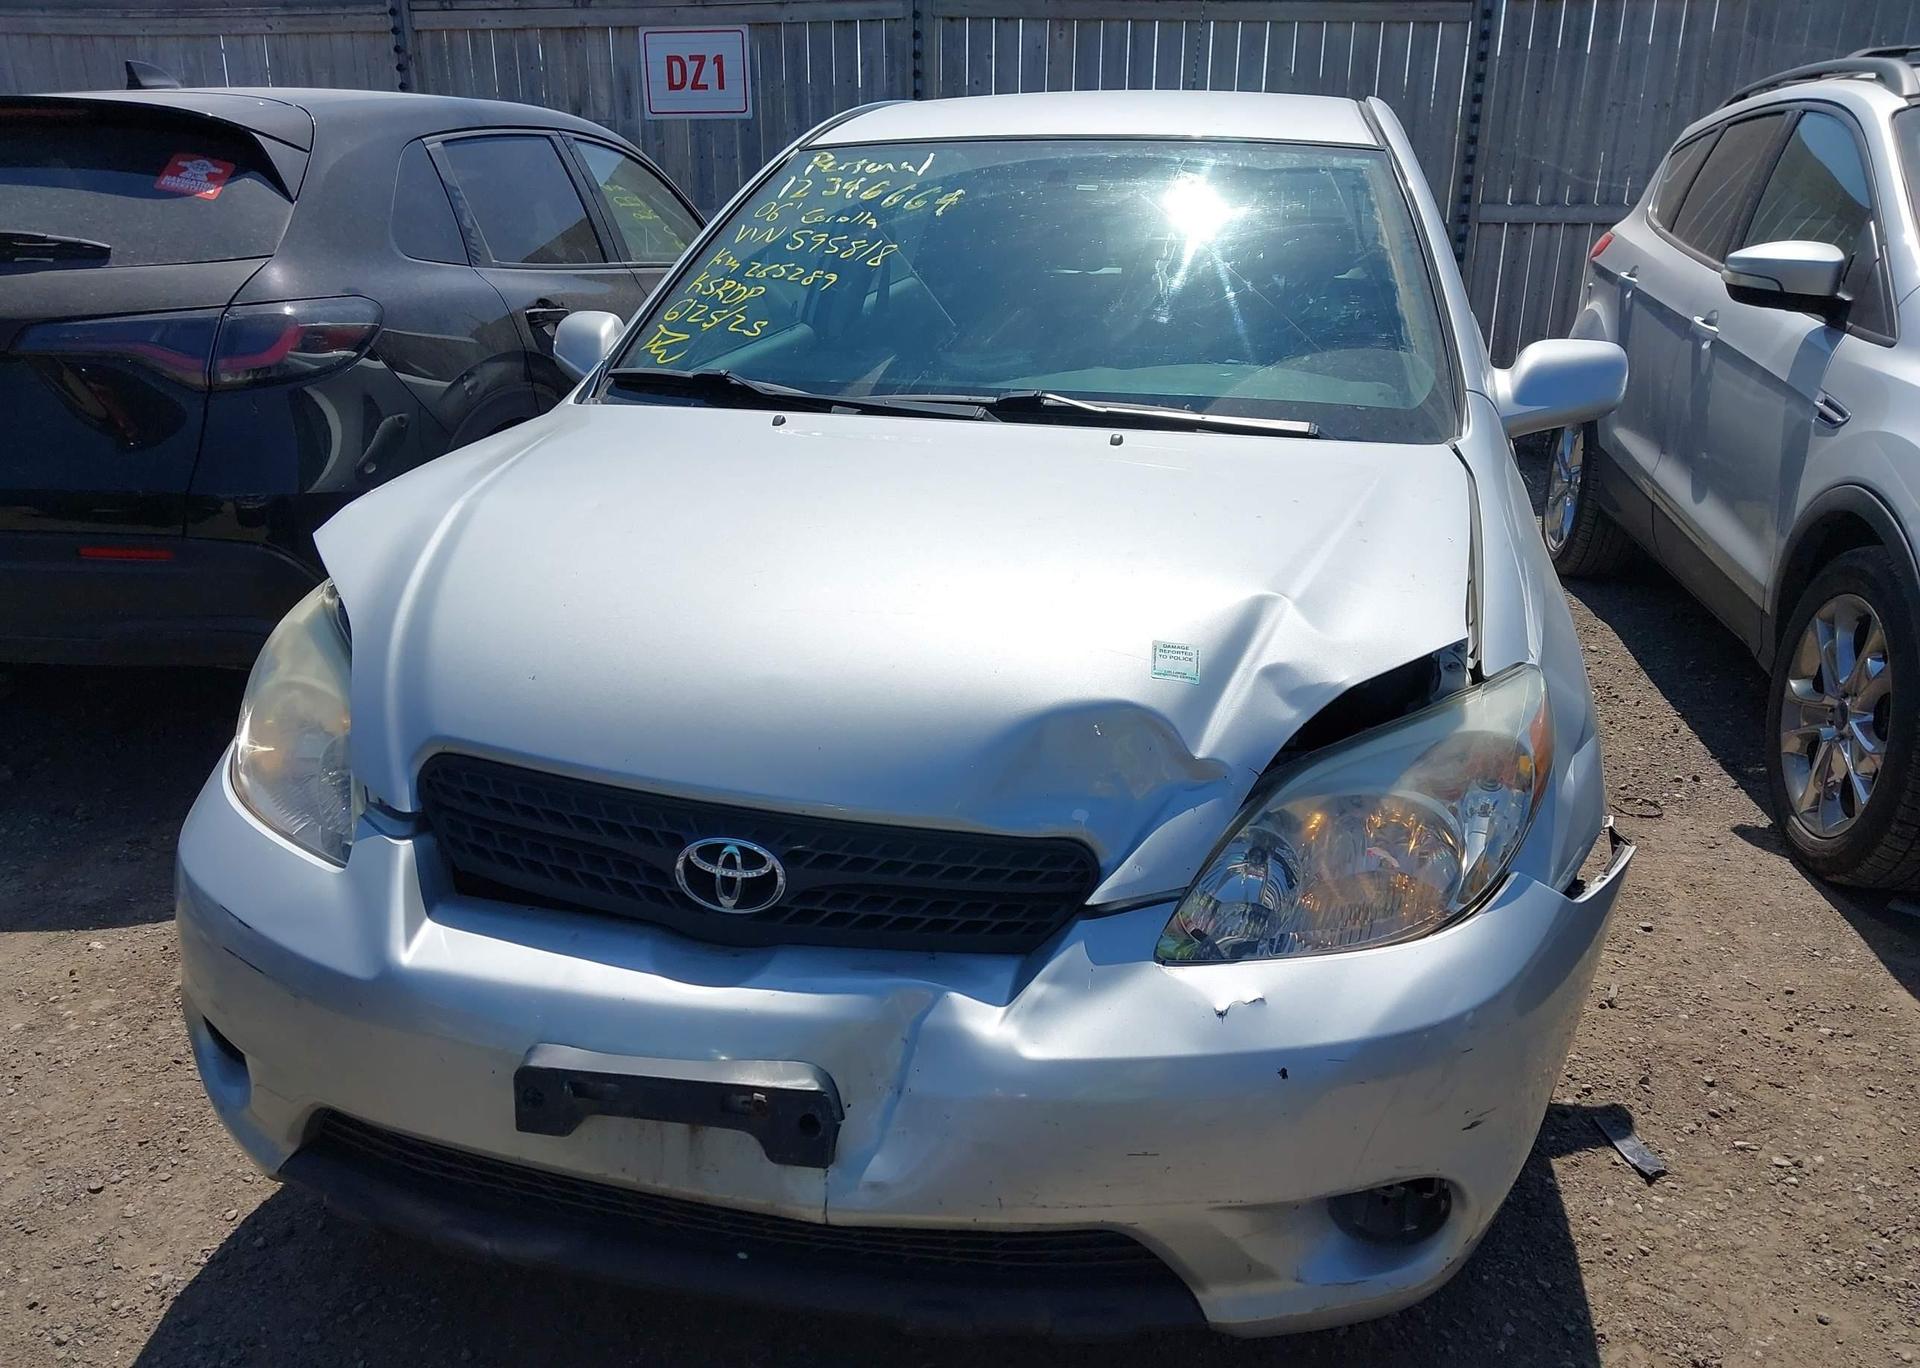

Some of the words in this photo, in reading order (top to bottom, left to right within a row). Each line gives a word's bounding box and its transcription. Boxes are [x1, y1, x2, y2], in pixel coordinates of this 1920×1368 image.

[665, 53, 726, 92] DZ1
[734, 224, 788, 245] VIN
[744, 260, 839, 292] 265289
